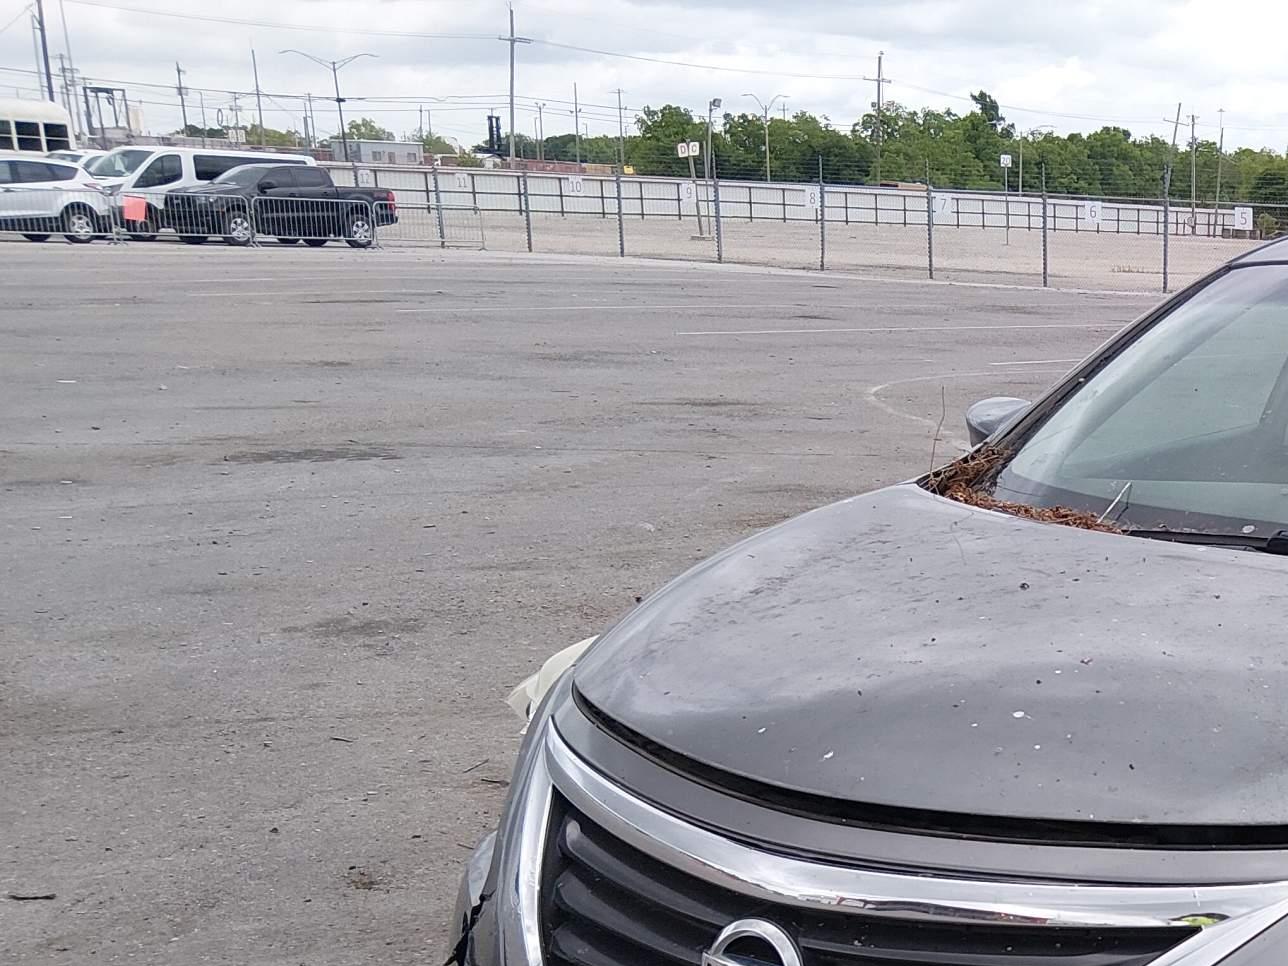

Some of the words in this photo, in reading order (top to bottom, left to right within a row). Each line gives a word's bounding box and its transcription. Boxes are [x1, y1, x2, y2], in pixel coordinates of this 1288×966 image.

[457, 177, 467, 188] 11
[570, 180, 582, 193] 10
[1089, 205, 1097, 219] 6
[1240, 211, 1247, 226] 5
